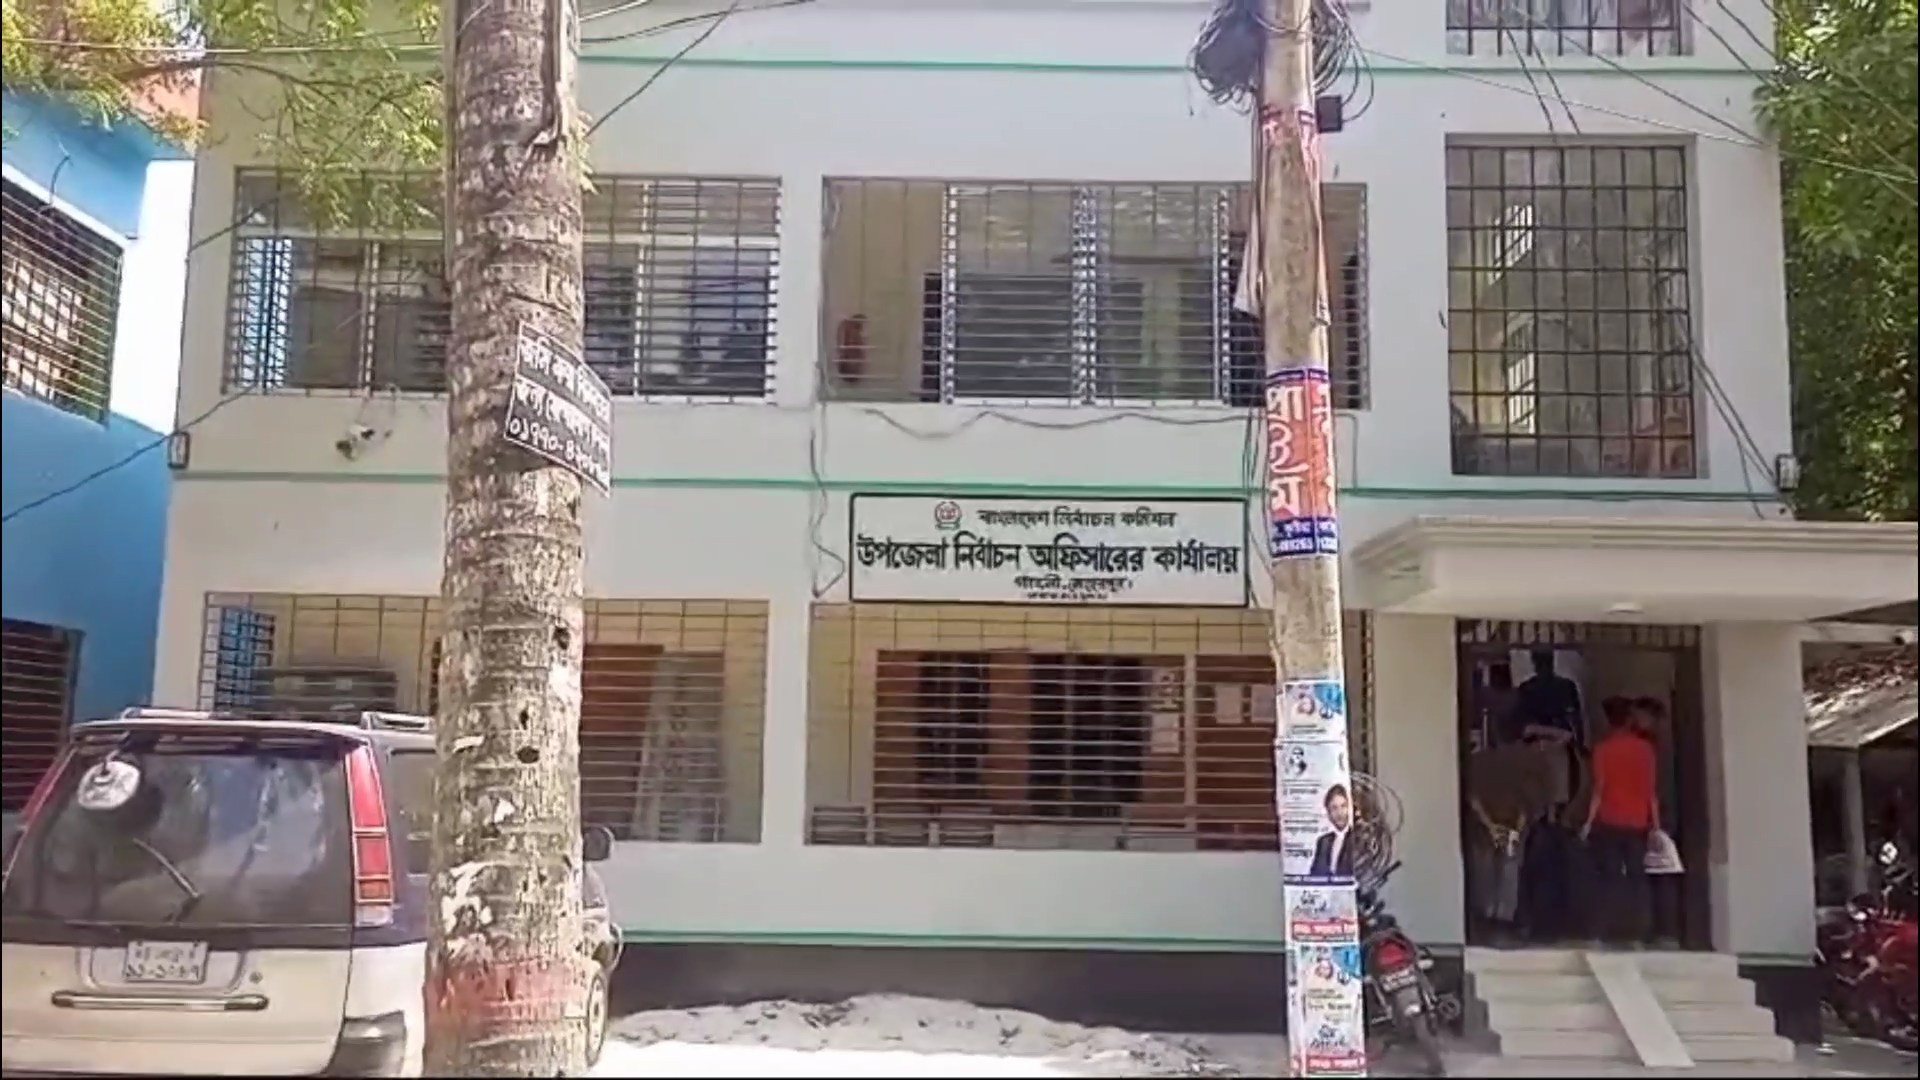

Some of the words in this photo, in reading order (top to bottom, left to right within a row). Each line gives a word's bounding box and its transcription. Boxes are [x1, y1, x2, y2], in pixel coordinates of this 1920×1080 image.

[976, 508, 1049, 529] বাংলাদেশ
[1053, 504, 1115, 527] নির্বাচন
[1120, 505, 1177, 528] কমিশন
[855, 533, 949, 571] উপজেলা
[953, 530, 1021, 571] নির্বাচন
[1026, 531, 1146, 573] অফিসারের
[1151, 536, 1240, 574] কার্যালয়
